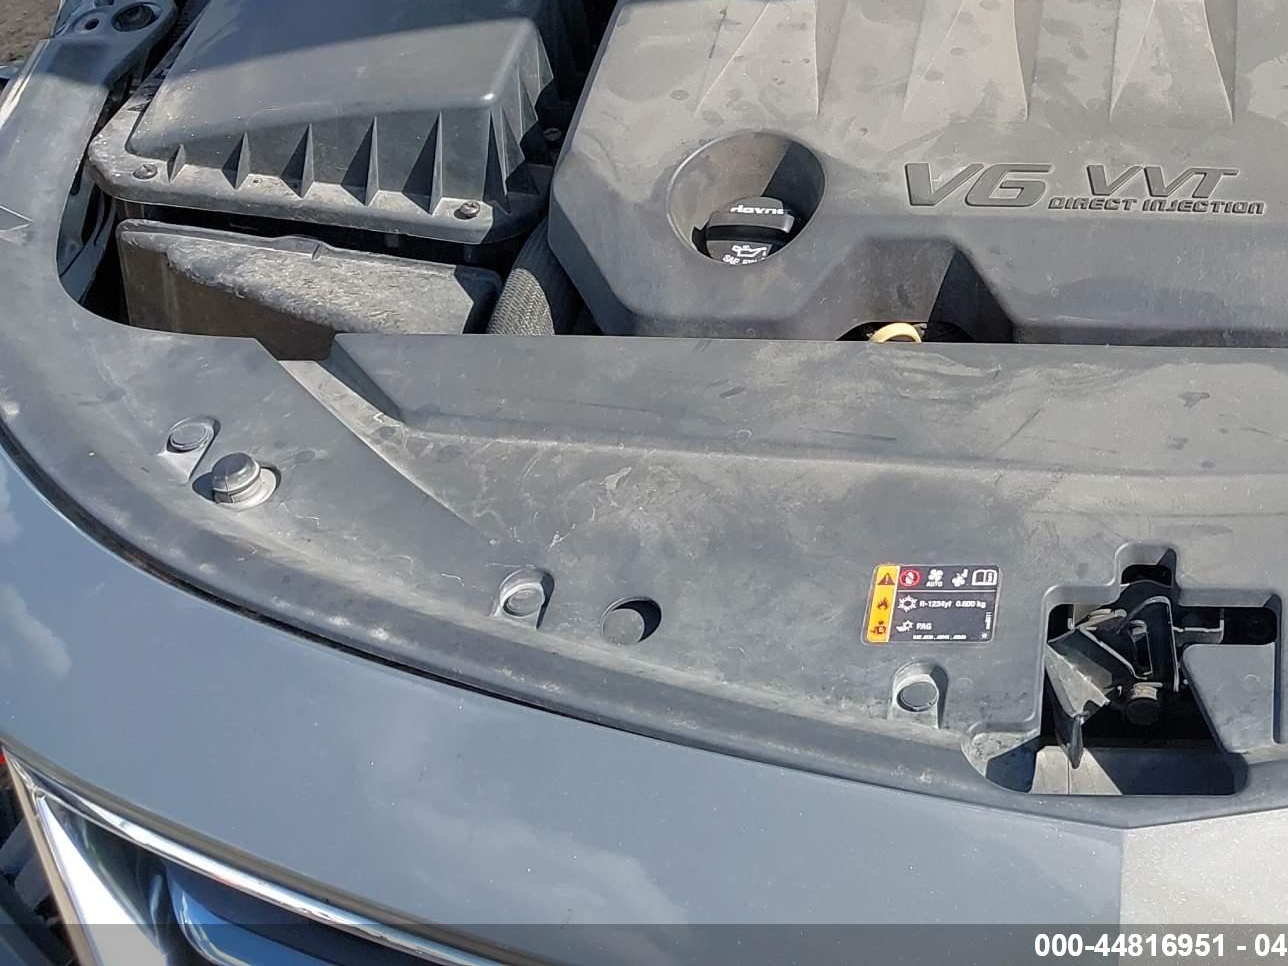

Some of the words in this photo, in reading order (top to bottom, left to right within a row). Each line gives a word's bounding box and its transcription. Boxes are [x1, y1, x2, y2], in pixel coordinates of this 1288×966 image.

[905, 163, 1052, 207] V6
[1086, 165, 1239, 199] VVT
[1048, 197, 1138, 211] DIRECT
[1142, 199, 1264, 215] INJECTION
[916, 622, 933, 631] PAG
